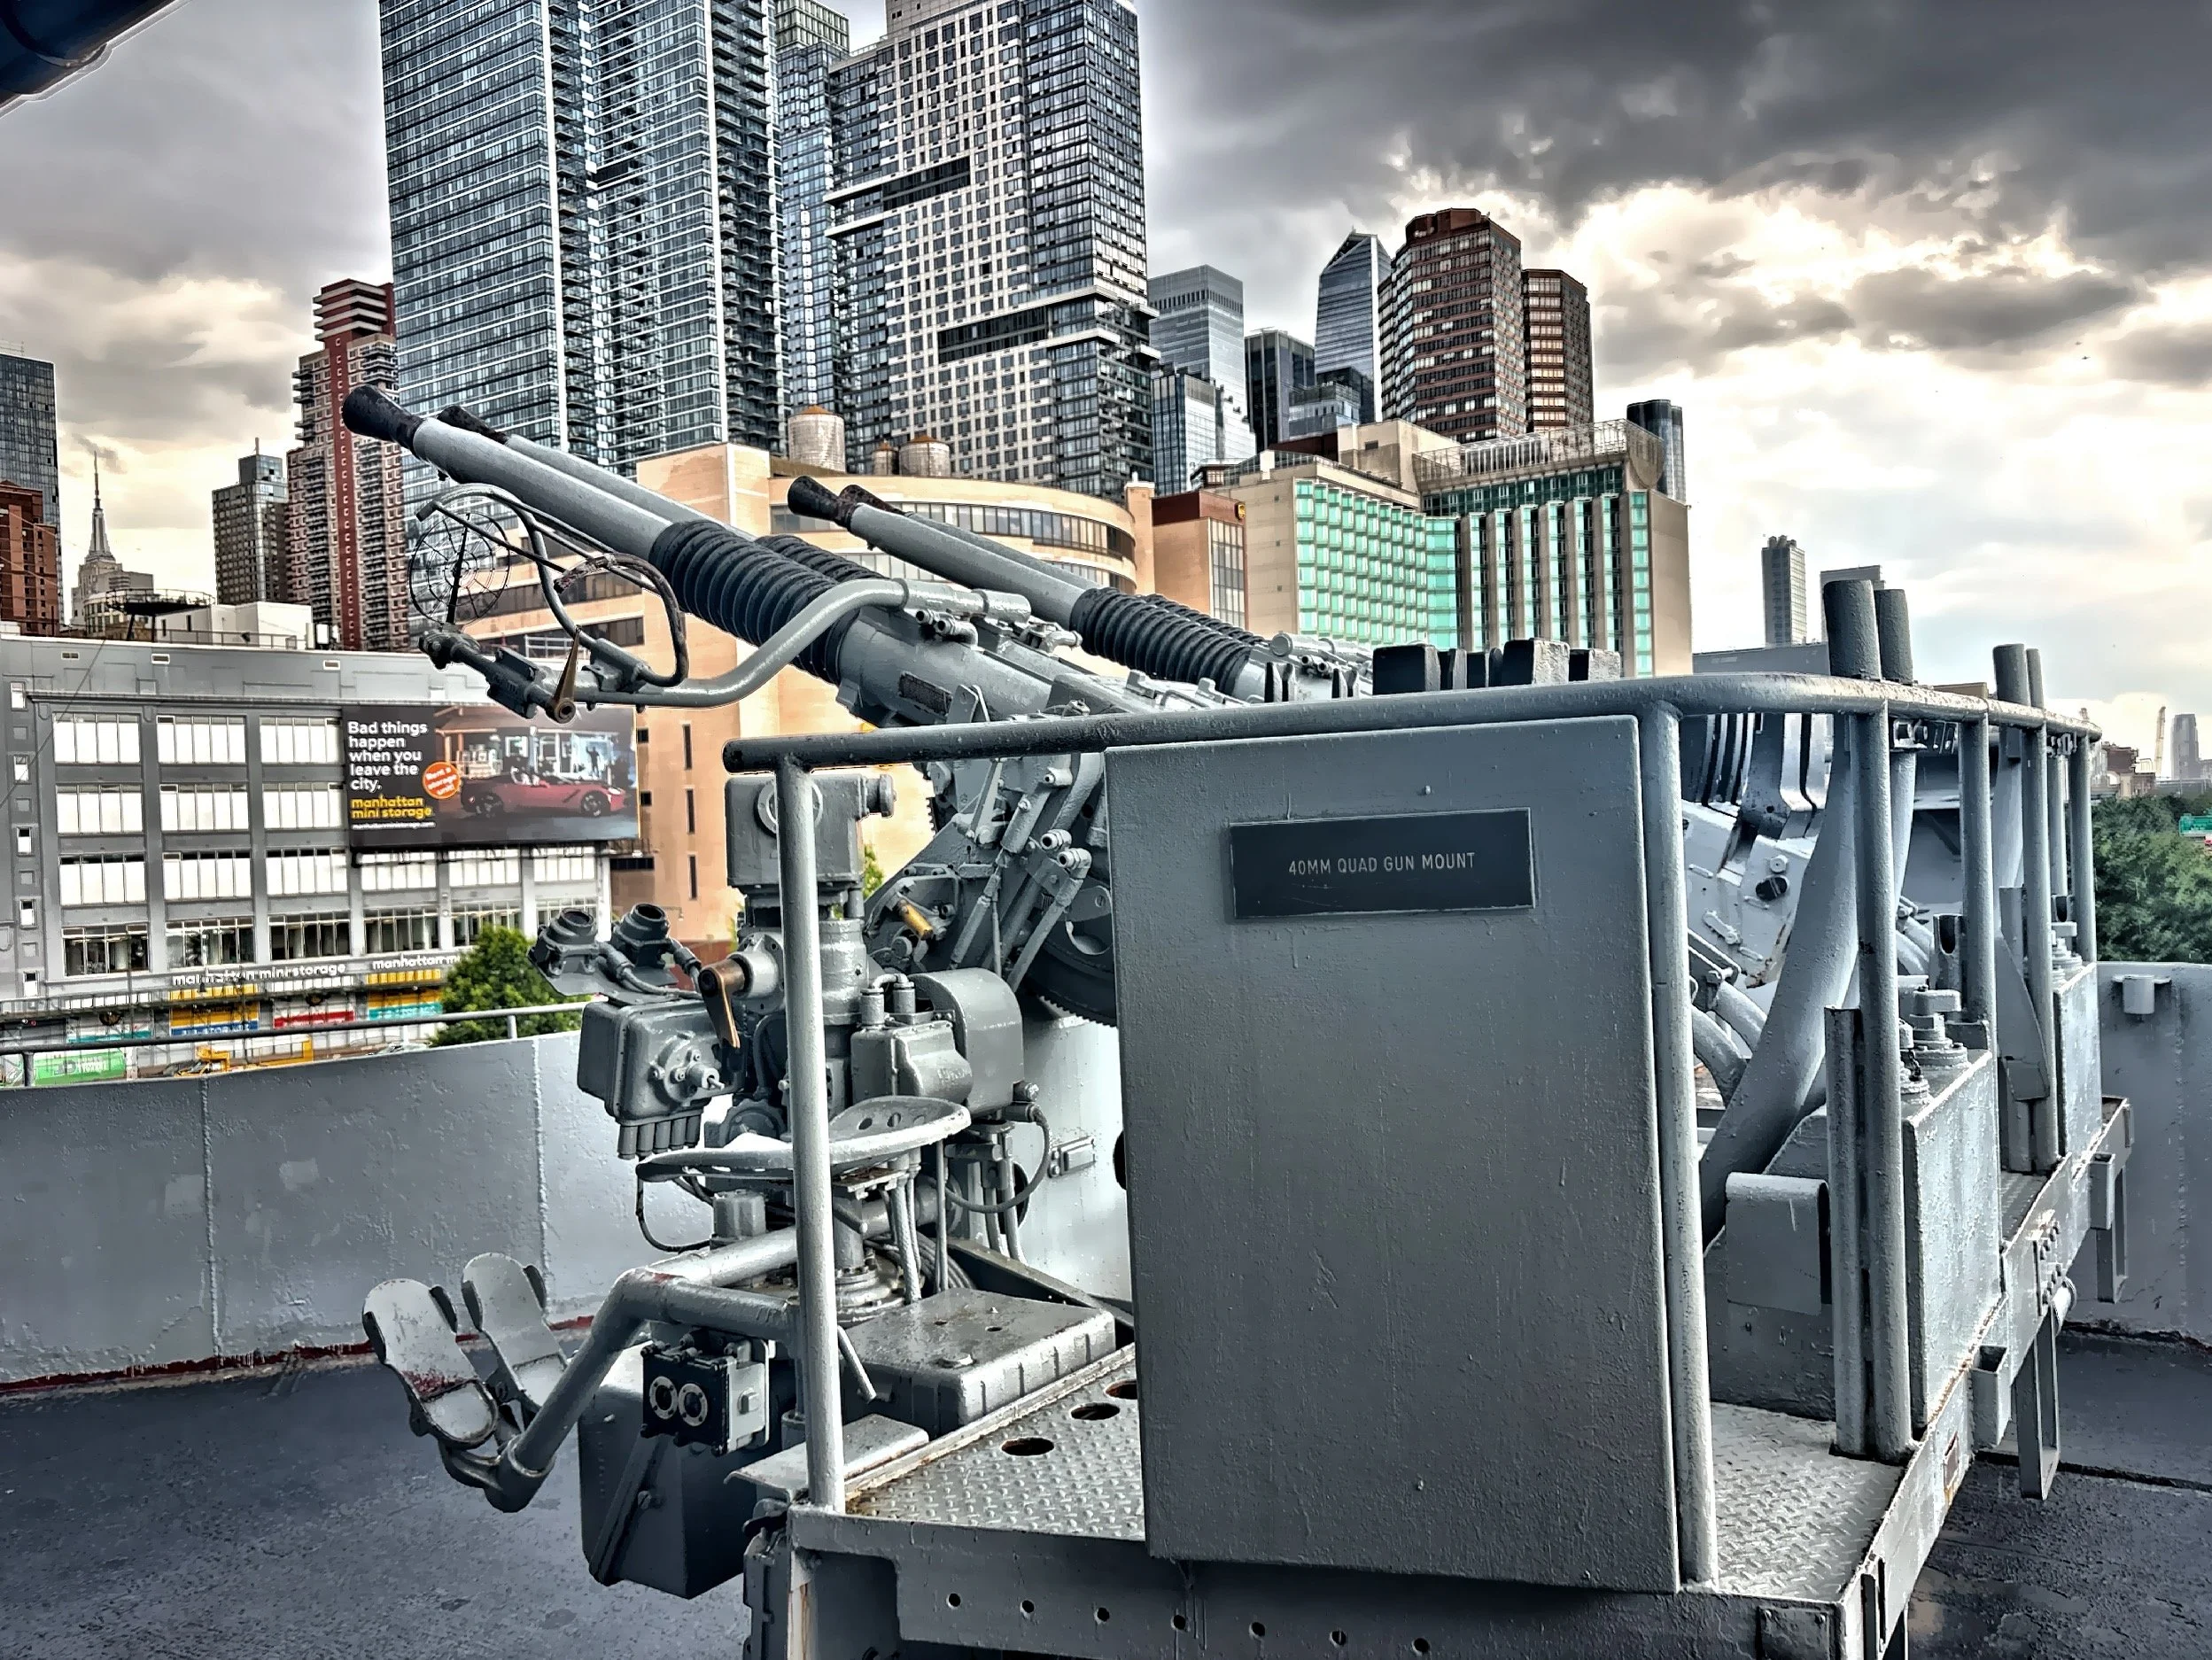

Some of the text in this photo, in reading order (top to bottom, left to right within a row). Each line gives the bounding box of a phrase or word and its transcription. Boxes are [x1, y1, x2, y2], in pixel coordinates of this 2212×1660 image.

[347, 720, 428, 737] Bad things
[348, 735, 406, 750] happen
[348, 749, 422, 764] when you
[350, 762, 419, 776] leave the
[350, 777, 382, 793] city.
[352, 794, 423, 808] manhattan
[351, 806, 432, 819] mini storage
[1289, 852, 1475, 876] 40MM QUAD GUN MOUNT
[372, 953, 442, 969] manhattan
[260, 966, 290, 979] mini
[291, 963, 346, 976] storage
